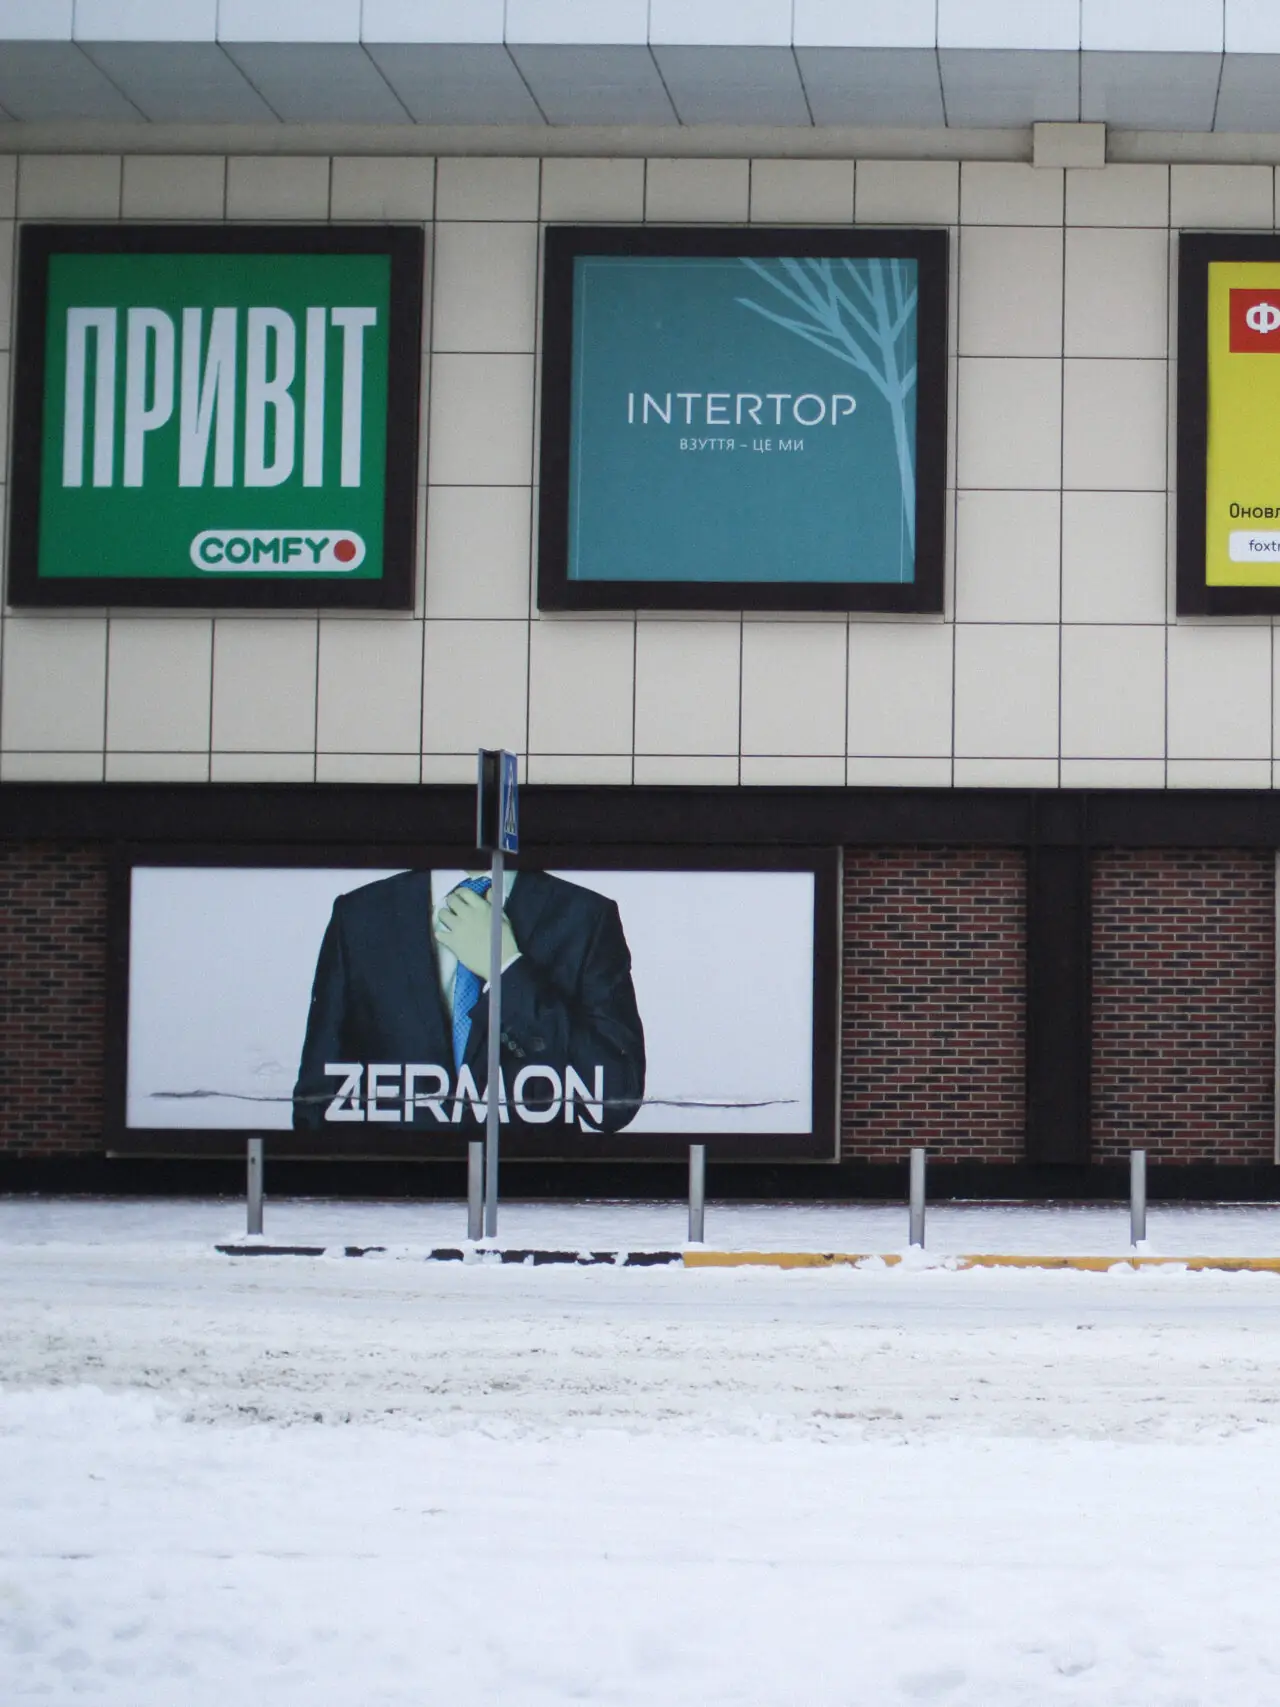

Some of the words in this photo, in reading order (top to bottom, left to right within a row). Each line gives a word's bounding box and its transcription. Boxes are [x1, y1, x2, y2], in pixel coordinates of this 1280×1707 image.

[62, 306, 378, 488] ПРИВІТ
[627, 392, 857, 426] INTERTOP
[679, 438, 735, 451] ВЗУТТЯ
[753, 439, 772, 453] ЦЕ
[778, 440, 804, 451] МИ
[199, 537, 330, 564] COMFY
[324, 1063, 604, 1123] ZERMON
